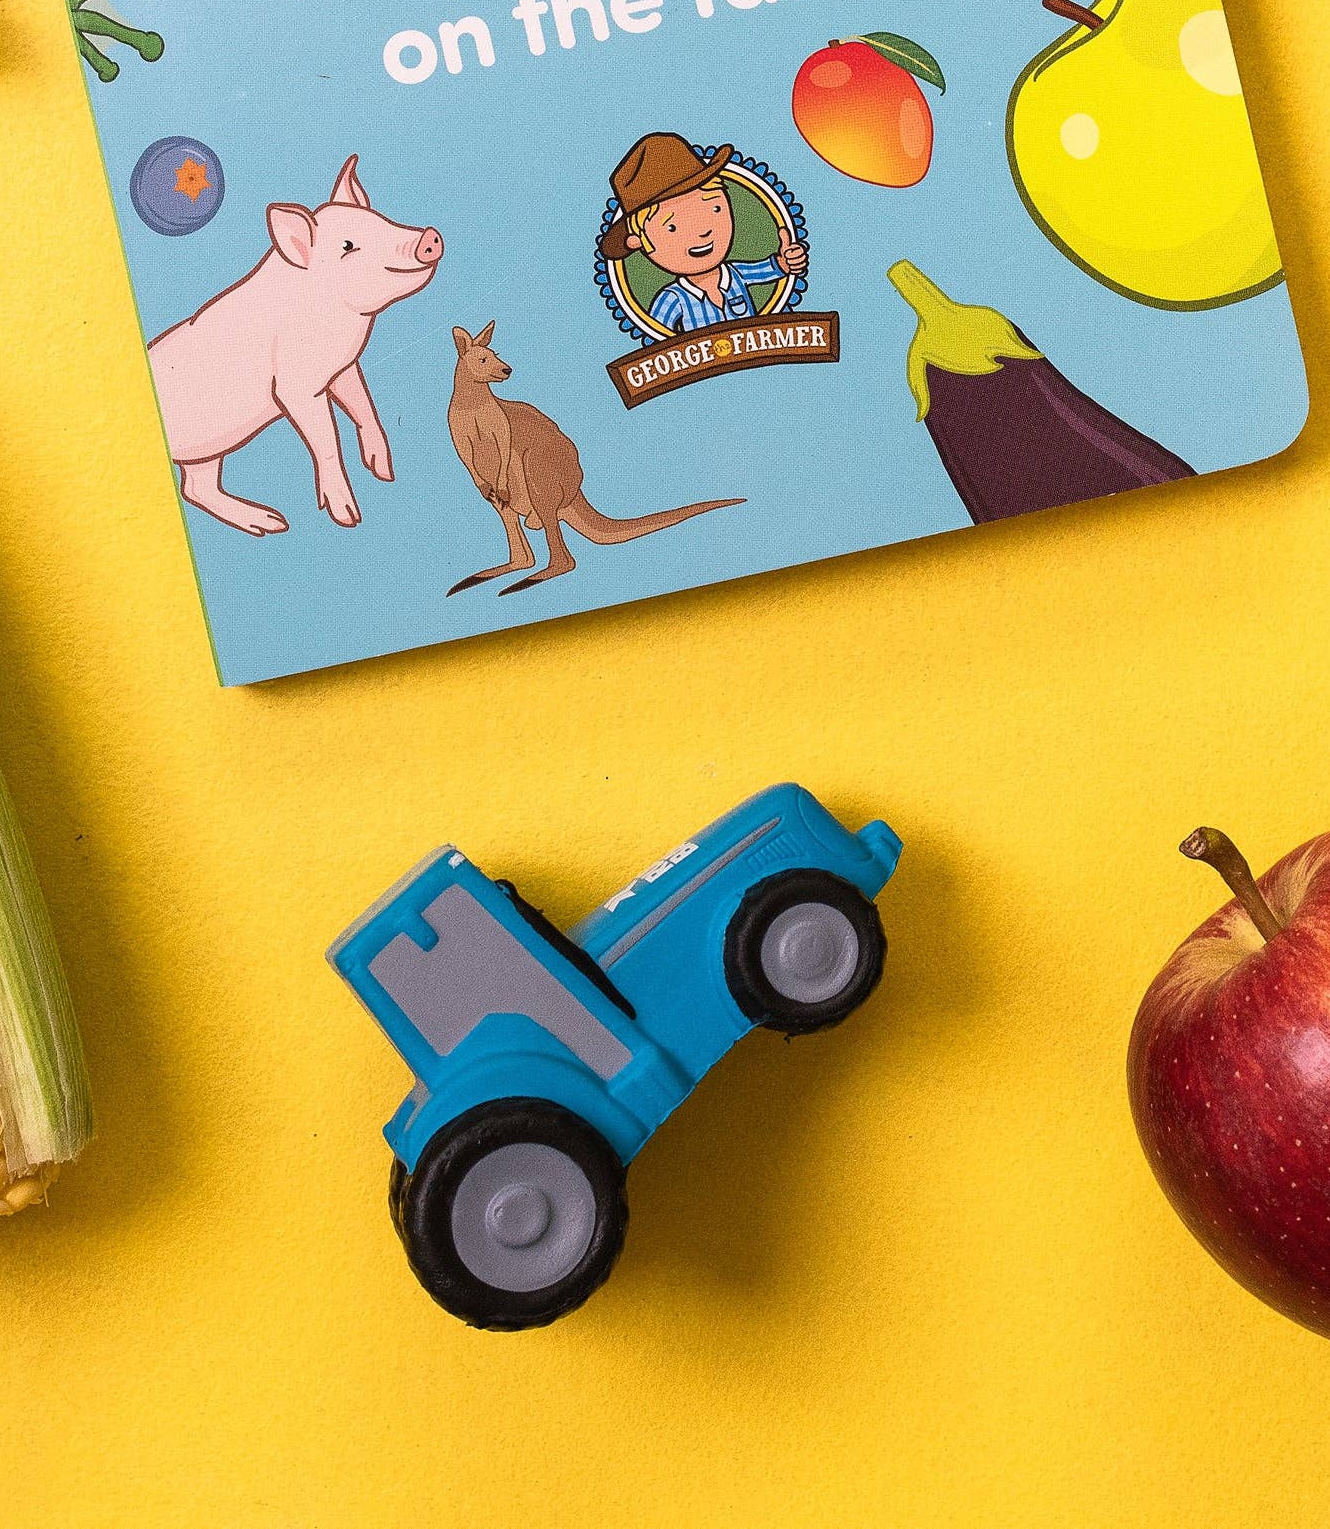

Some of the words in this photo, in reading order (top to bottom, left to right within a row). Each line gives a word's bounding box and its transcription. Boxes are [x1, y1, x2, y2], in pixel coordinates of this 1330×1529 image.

[382, 15, 496, 85] on
[626, 339, 715, 388] GEORGE
[730, 325, 827, 355] FARMER
